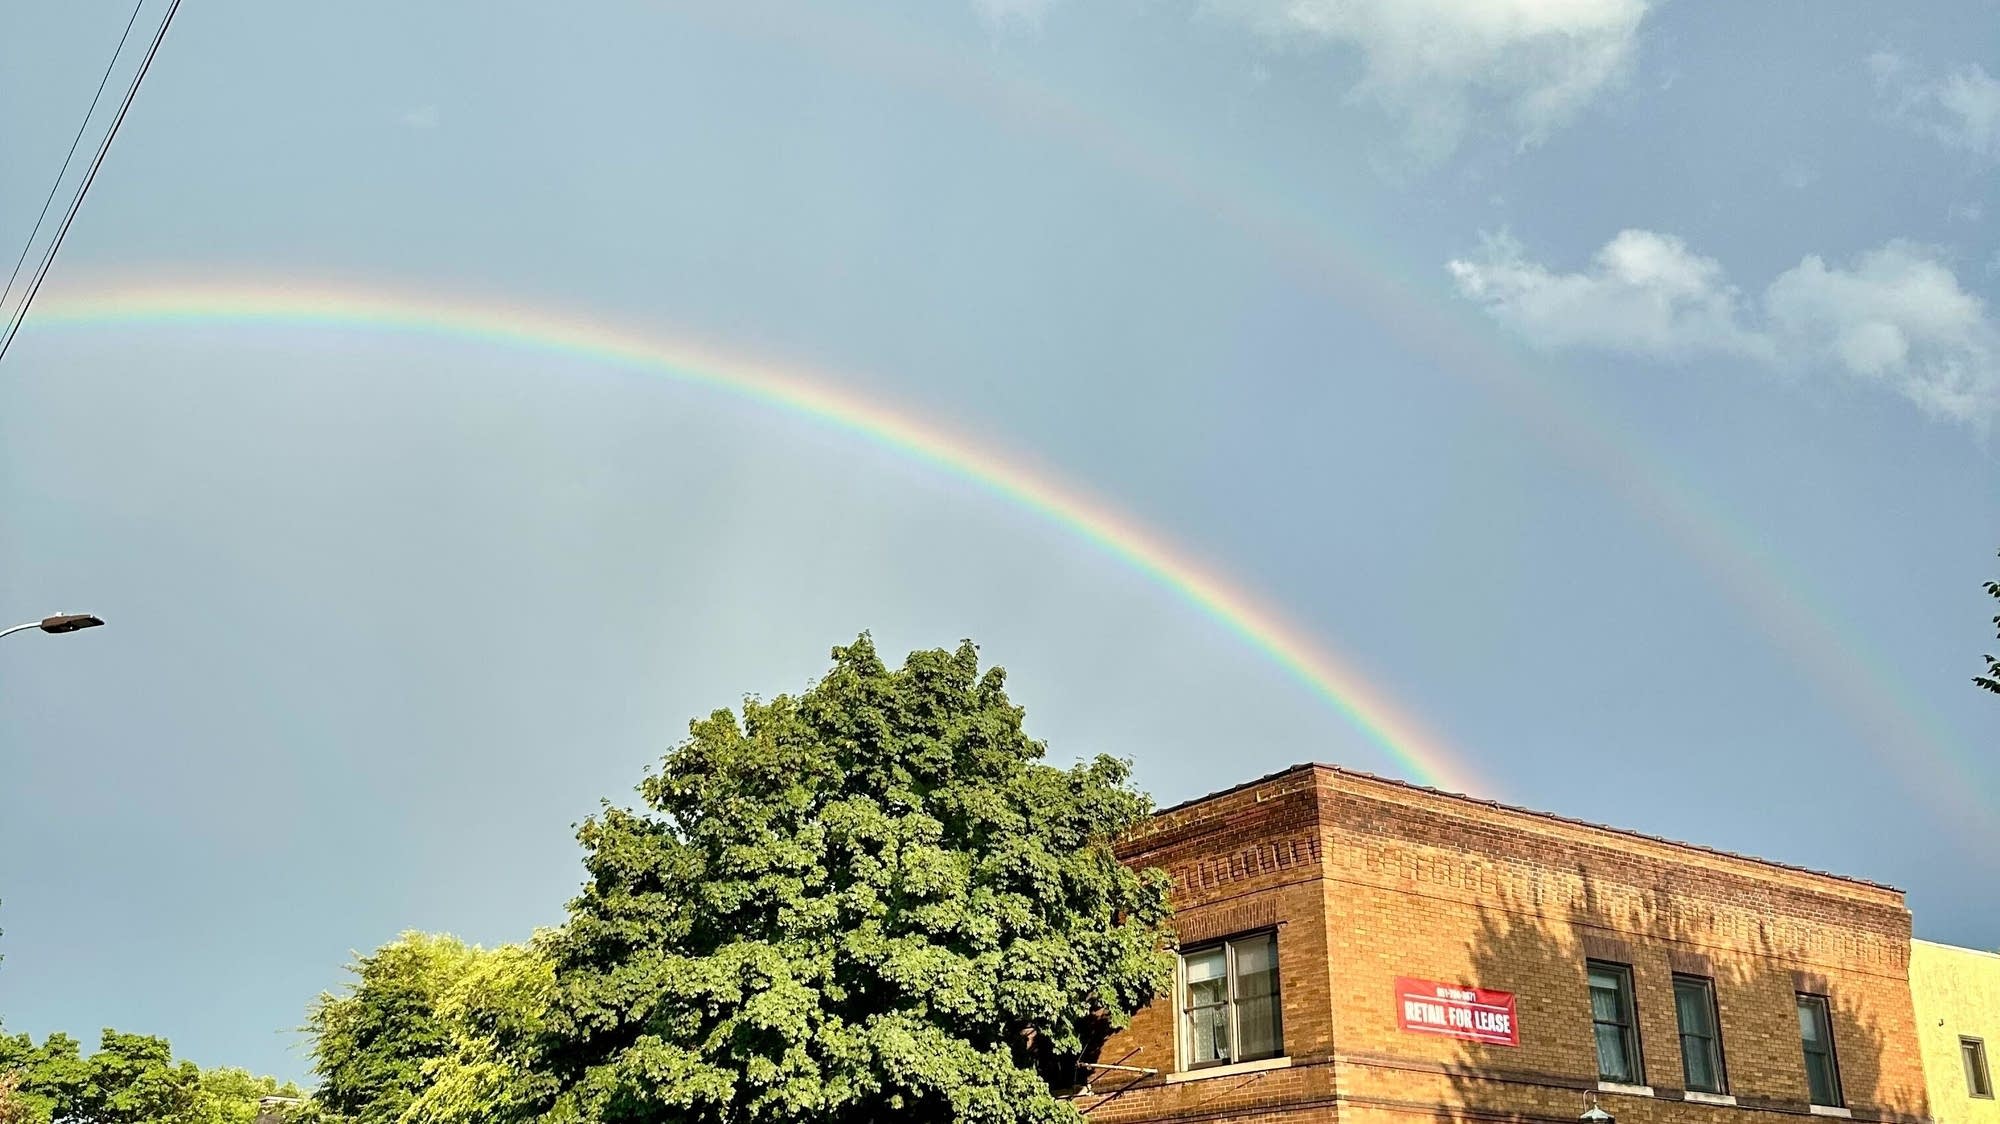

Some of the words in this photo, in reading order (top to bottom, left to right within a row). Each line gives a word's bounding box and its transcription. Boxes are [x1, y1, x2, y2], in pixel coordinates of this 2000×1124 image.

[1404, 1001, 1447, 1025] RETAIL
[1448, 1007, 1473, 1028] FOR
[1474, 1010, 1511, 1034] LEASE
